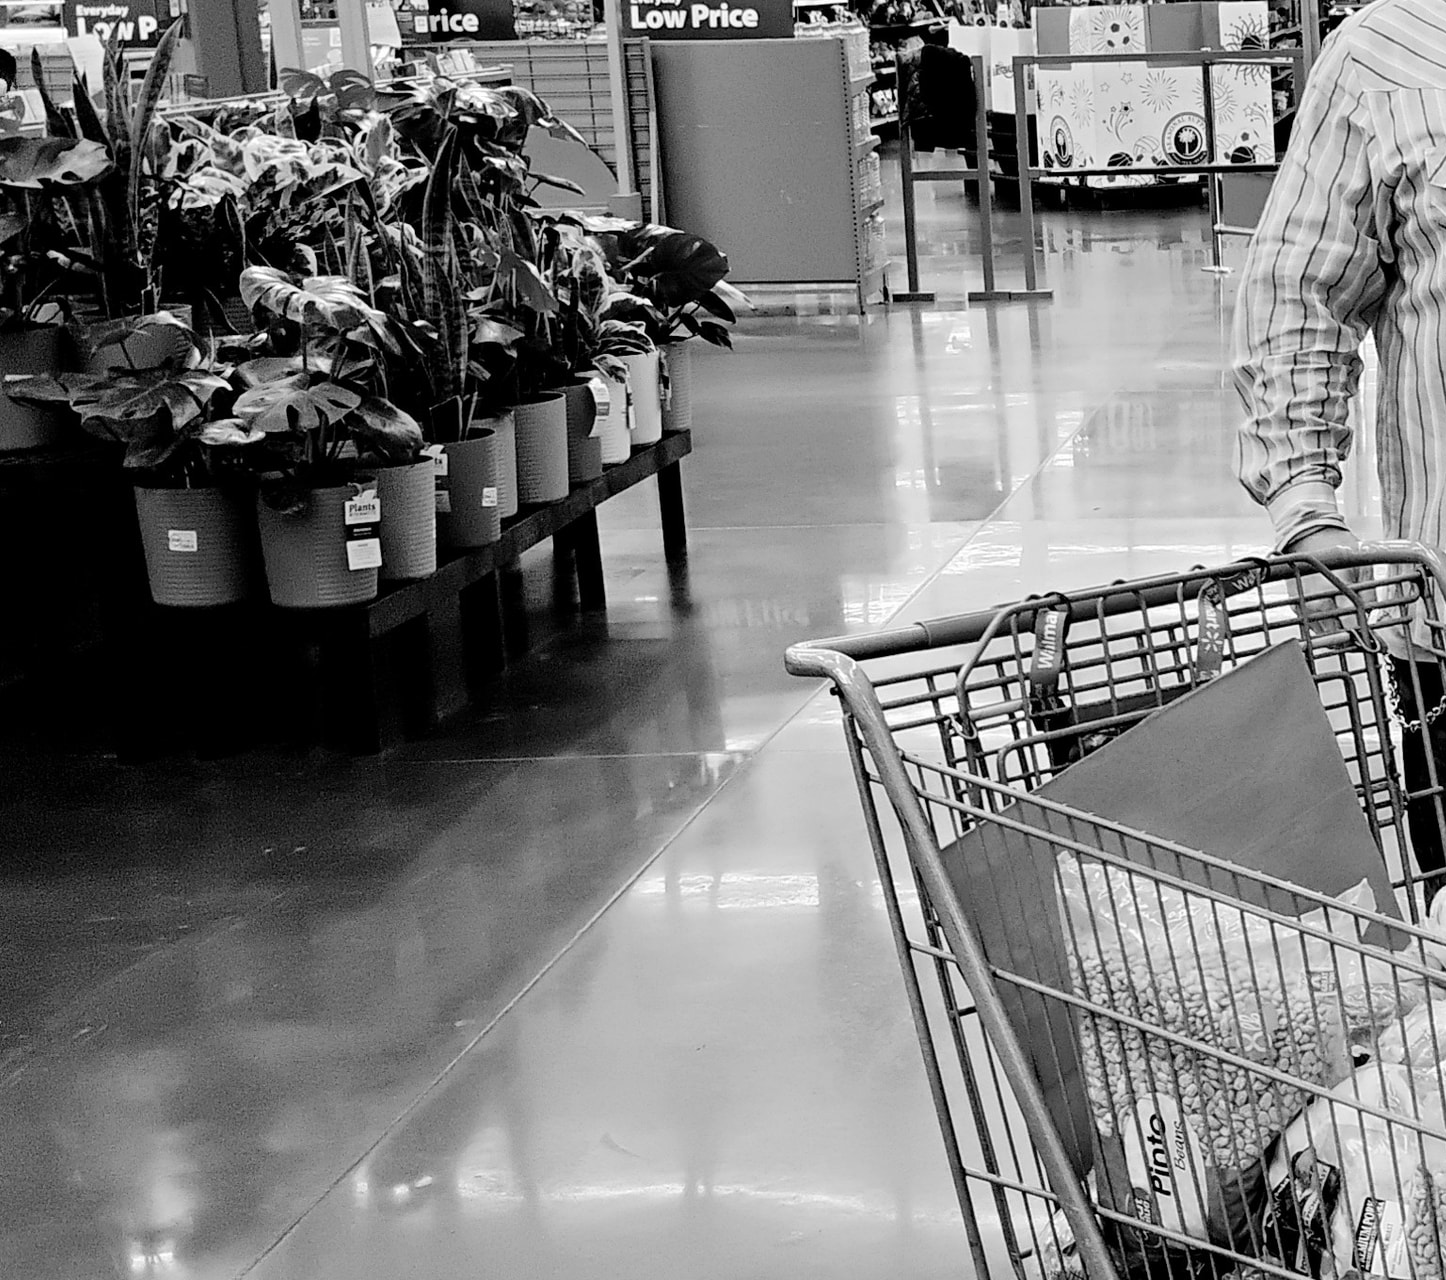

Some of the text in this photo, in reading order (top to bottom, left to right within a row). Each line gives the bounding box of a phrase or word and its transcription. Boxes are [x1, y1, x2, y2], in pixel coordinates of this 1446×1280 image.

[75, 3, 130, 19] Everyday
[428, 8, 480, 33] rice
[629, 2, 759, 30] Low Price
[348, 503, 377, 513] Plants
[1146, 1113, 1172, 1197] Pinto
[1173, 1120, 1187, 1172] Beans
